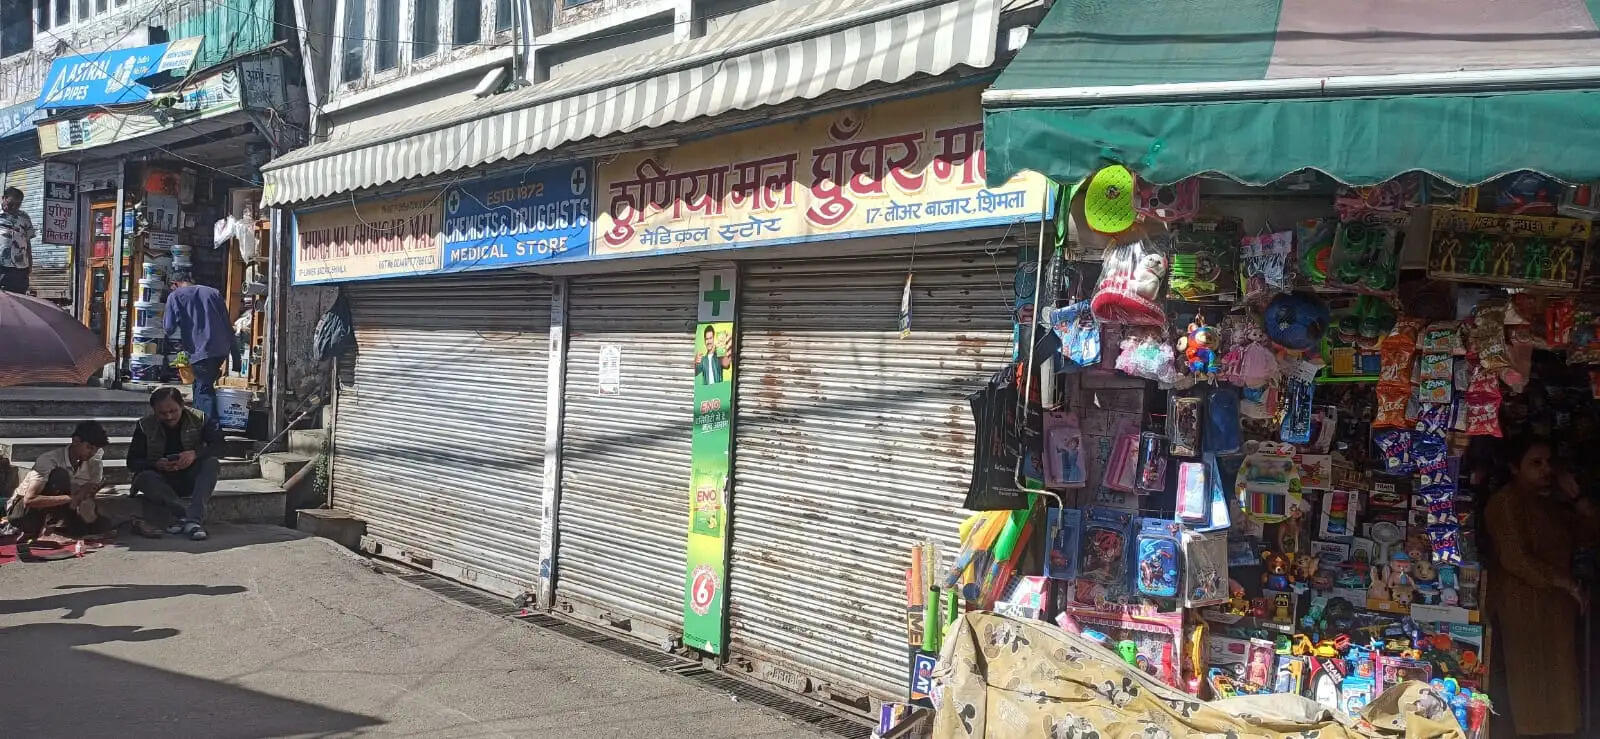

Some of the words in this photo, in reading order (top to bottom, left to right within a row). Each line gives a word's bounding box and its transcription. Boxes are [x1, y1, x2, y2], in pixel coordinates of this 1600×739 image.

[65, 56, 112, 82] ASTRAL
[63, 85, 89, 100] PIPES
[517, 182, 545, 200] 1872
[976, 189, 1027, 213] शिमला
[408, 213, 435, 250] MAL
[445, 211, 499, 244] CHEMISTS
[500, 214, 508, 236] &
[509, 198, 590, 235] DRUGGISTS
[639, 226, 710, 246] मेडिकल
[718, 215, 782, 241] स्टोर
[450, 244, 509, 262] MEDICAL
[516, 236, 569, 256] STORE
[700, 398, 721, 414] ENO
[696, 489, 717, 503] ENO
